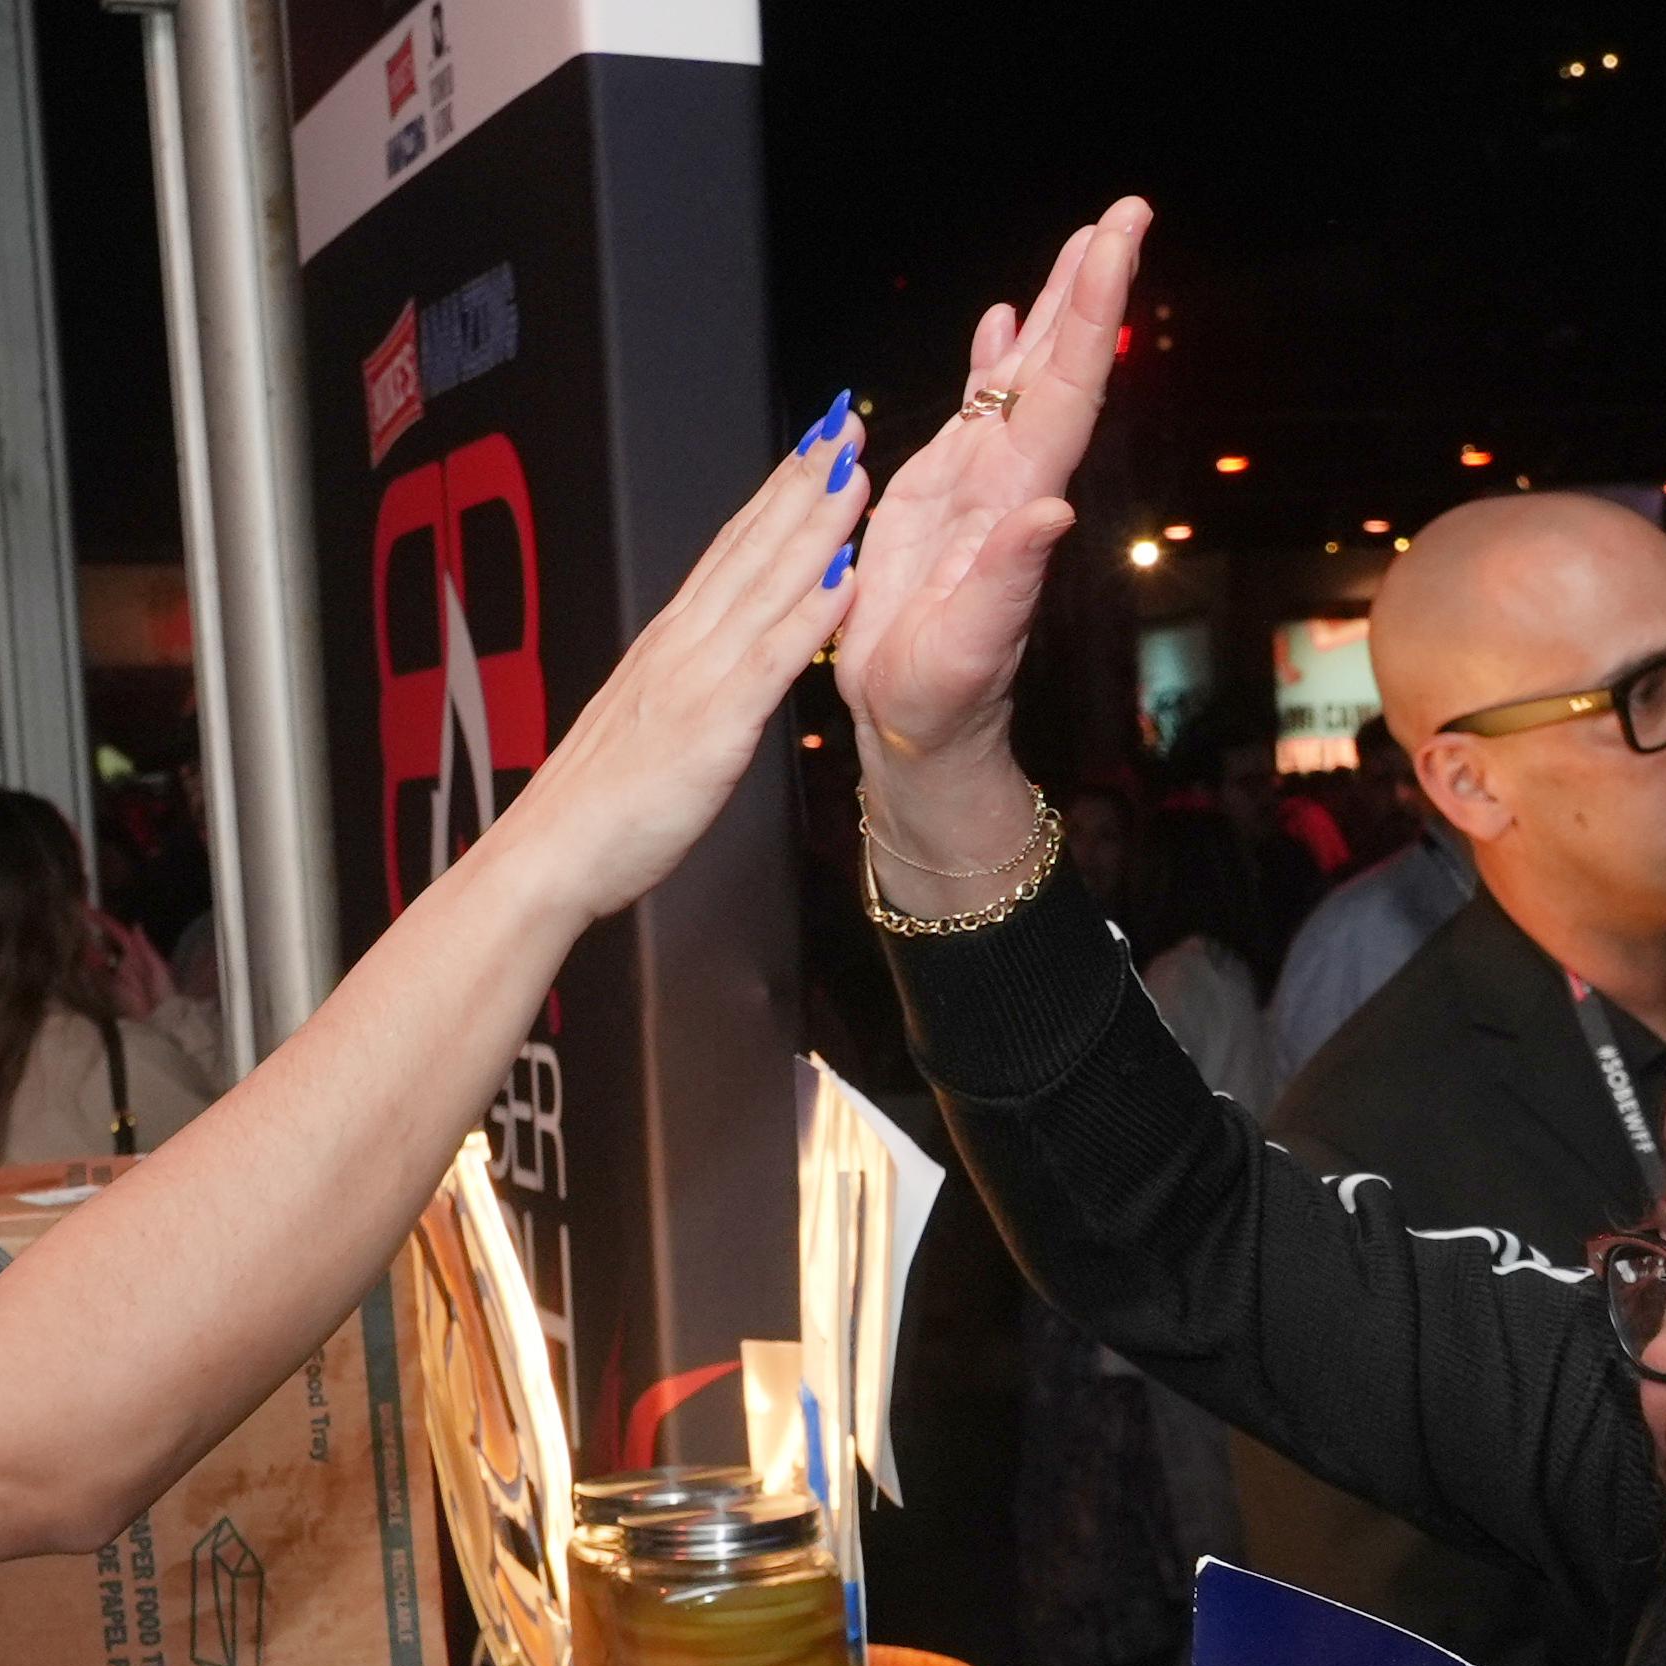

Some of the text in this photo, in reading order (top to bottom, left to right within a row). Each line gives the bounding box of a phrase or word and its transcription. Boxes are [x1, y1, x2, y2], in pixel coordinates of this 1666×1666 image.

[309, 1411, 332, 1463] Tray
[100, 1580, 128, 1653] PAPEL
[134, 1587, 162, 1647] FOOD
